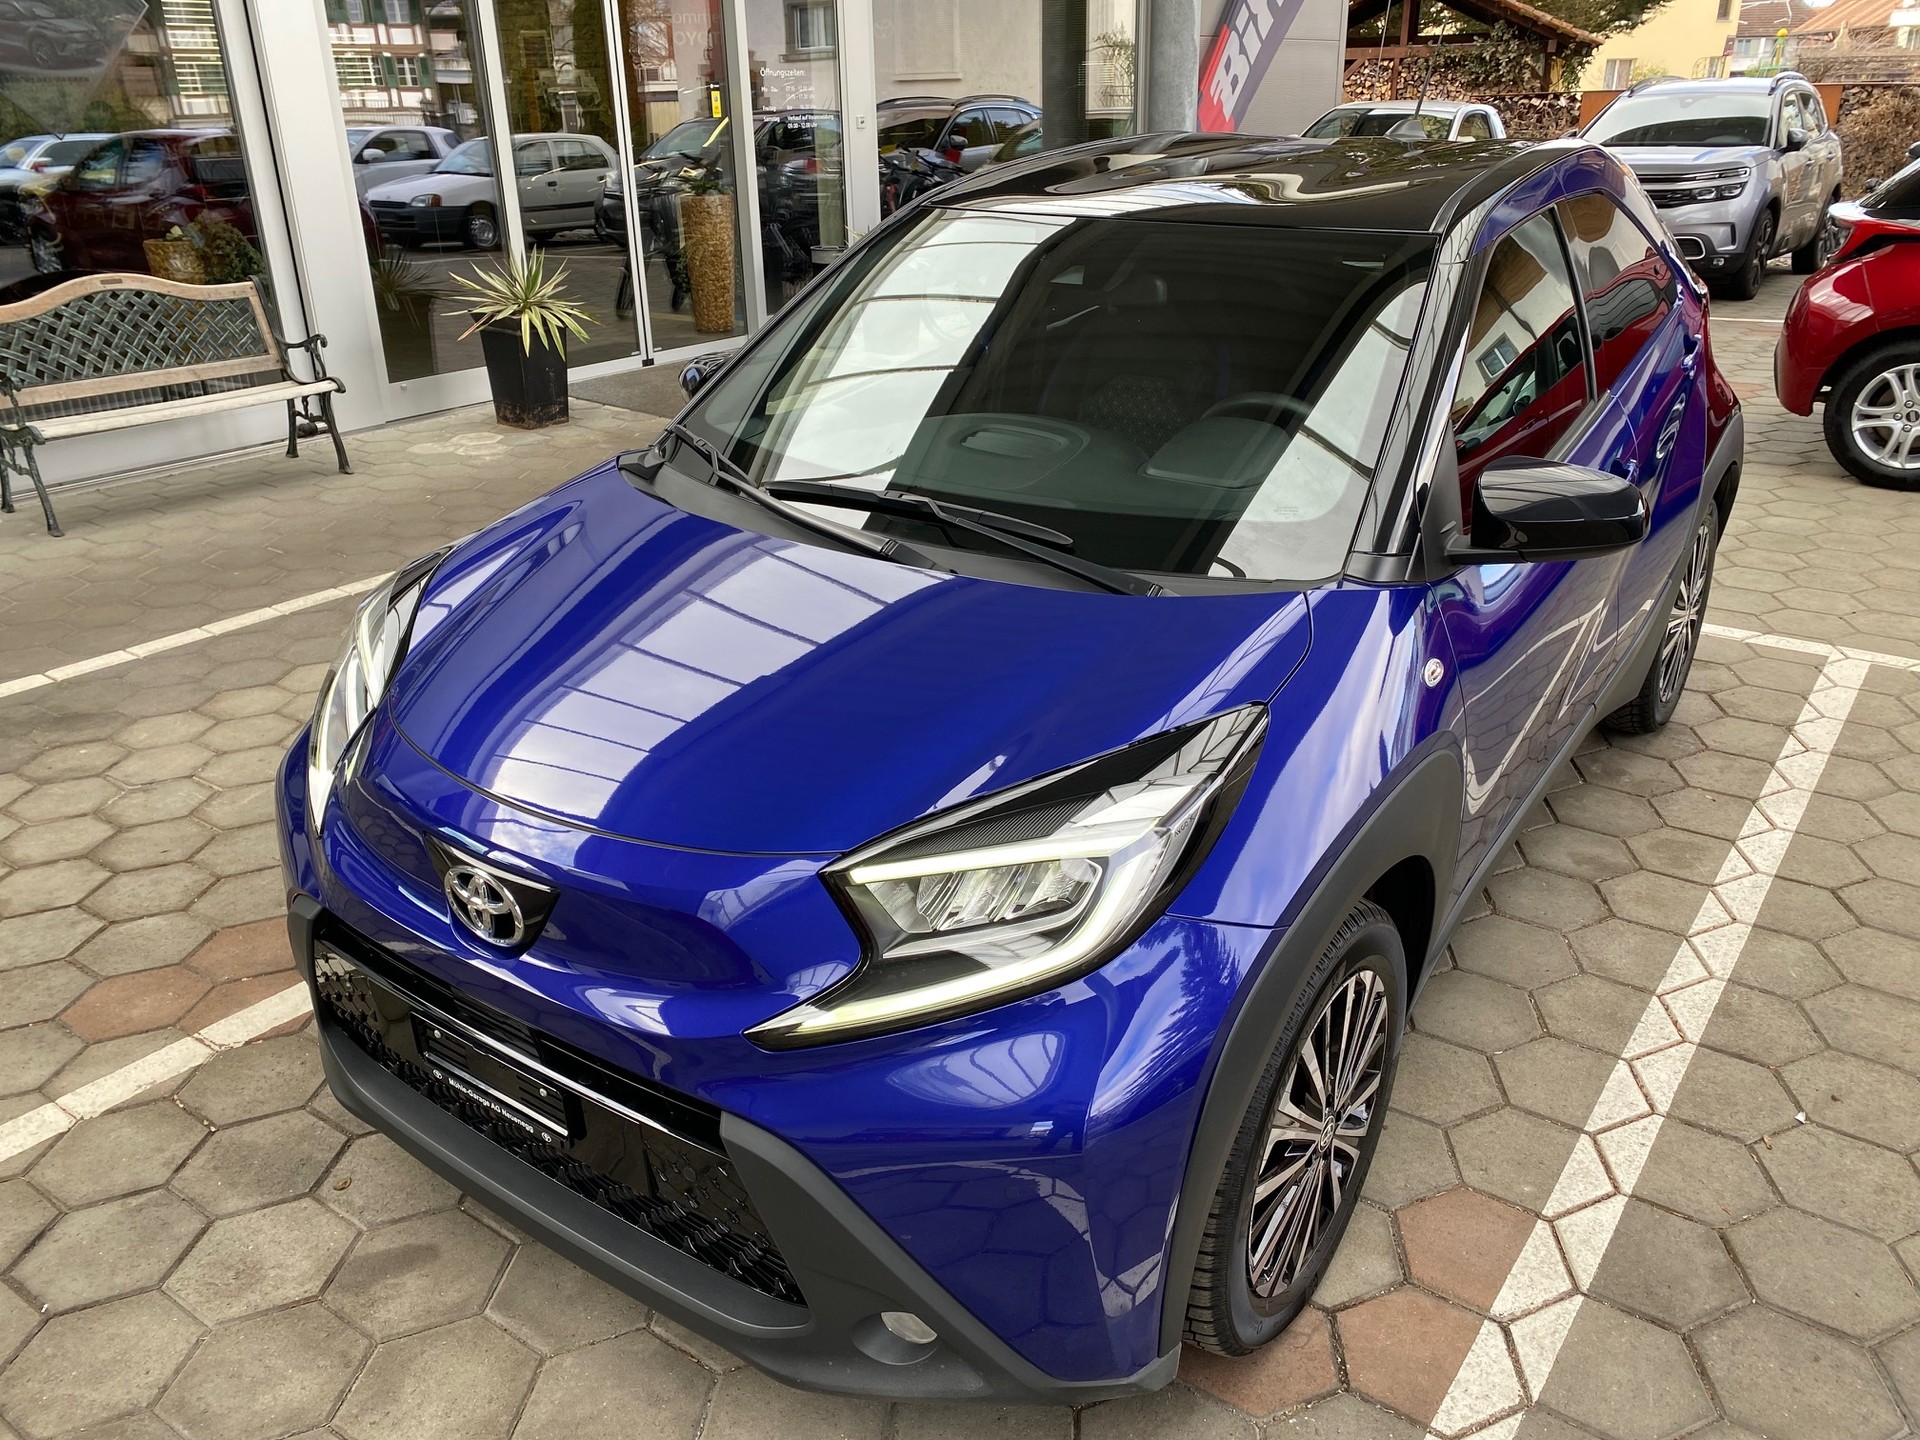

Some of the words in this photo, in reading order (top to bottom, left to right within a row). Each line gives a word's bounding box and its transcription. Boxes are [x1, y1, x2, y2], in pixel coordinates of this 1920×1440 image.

[760, 66, 806, 79] Öffnungszeiten:
[491, 1103, 501, 1113] AG
[501, 1108, 534, 1134] Neuenegg
